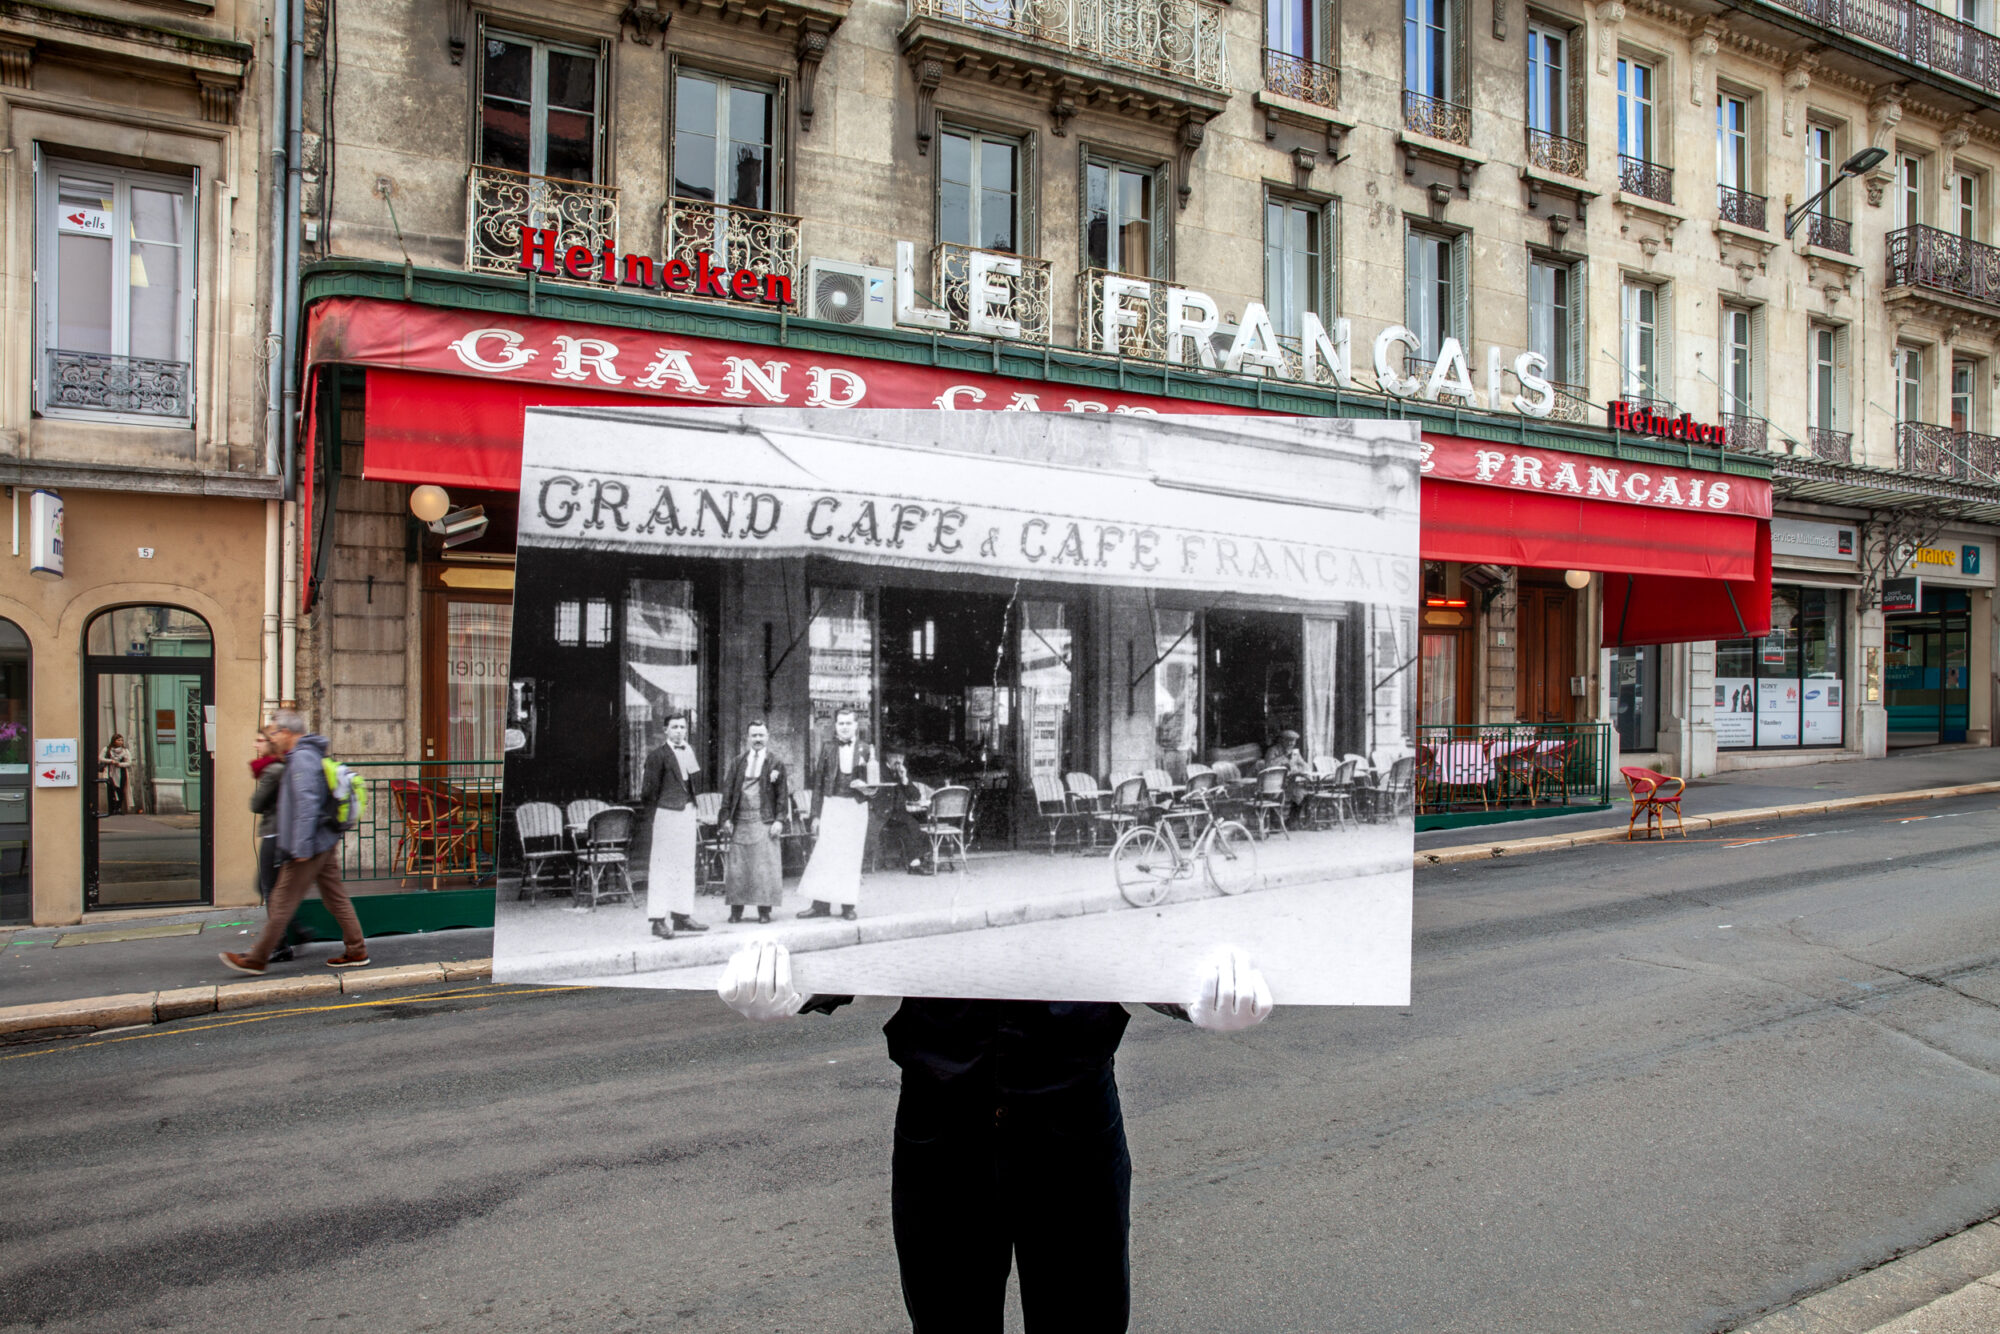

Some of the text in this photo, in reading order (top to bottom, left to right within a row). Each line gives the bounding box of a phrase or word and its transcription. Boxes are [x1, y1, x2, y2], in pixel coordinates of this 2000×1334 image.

[518, 225, 796, 304] Heineken
[896, 240, 1022, 338] LE
[447, 327, 867, 408] GRAND
[1474, 449, 1730, 509] FRANÇAIS
[1607, 399, 1727, 446] Heineken
[143, 548, 149, 557] 5
[537, 475, 783, 539] GRAND
[979, 527, 999, 558] &
